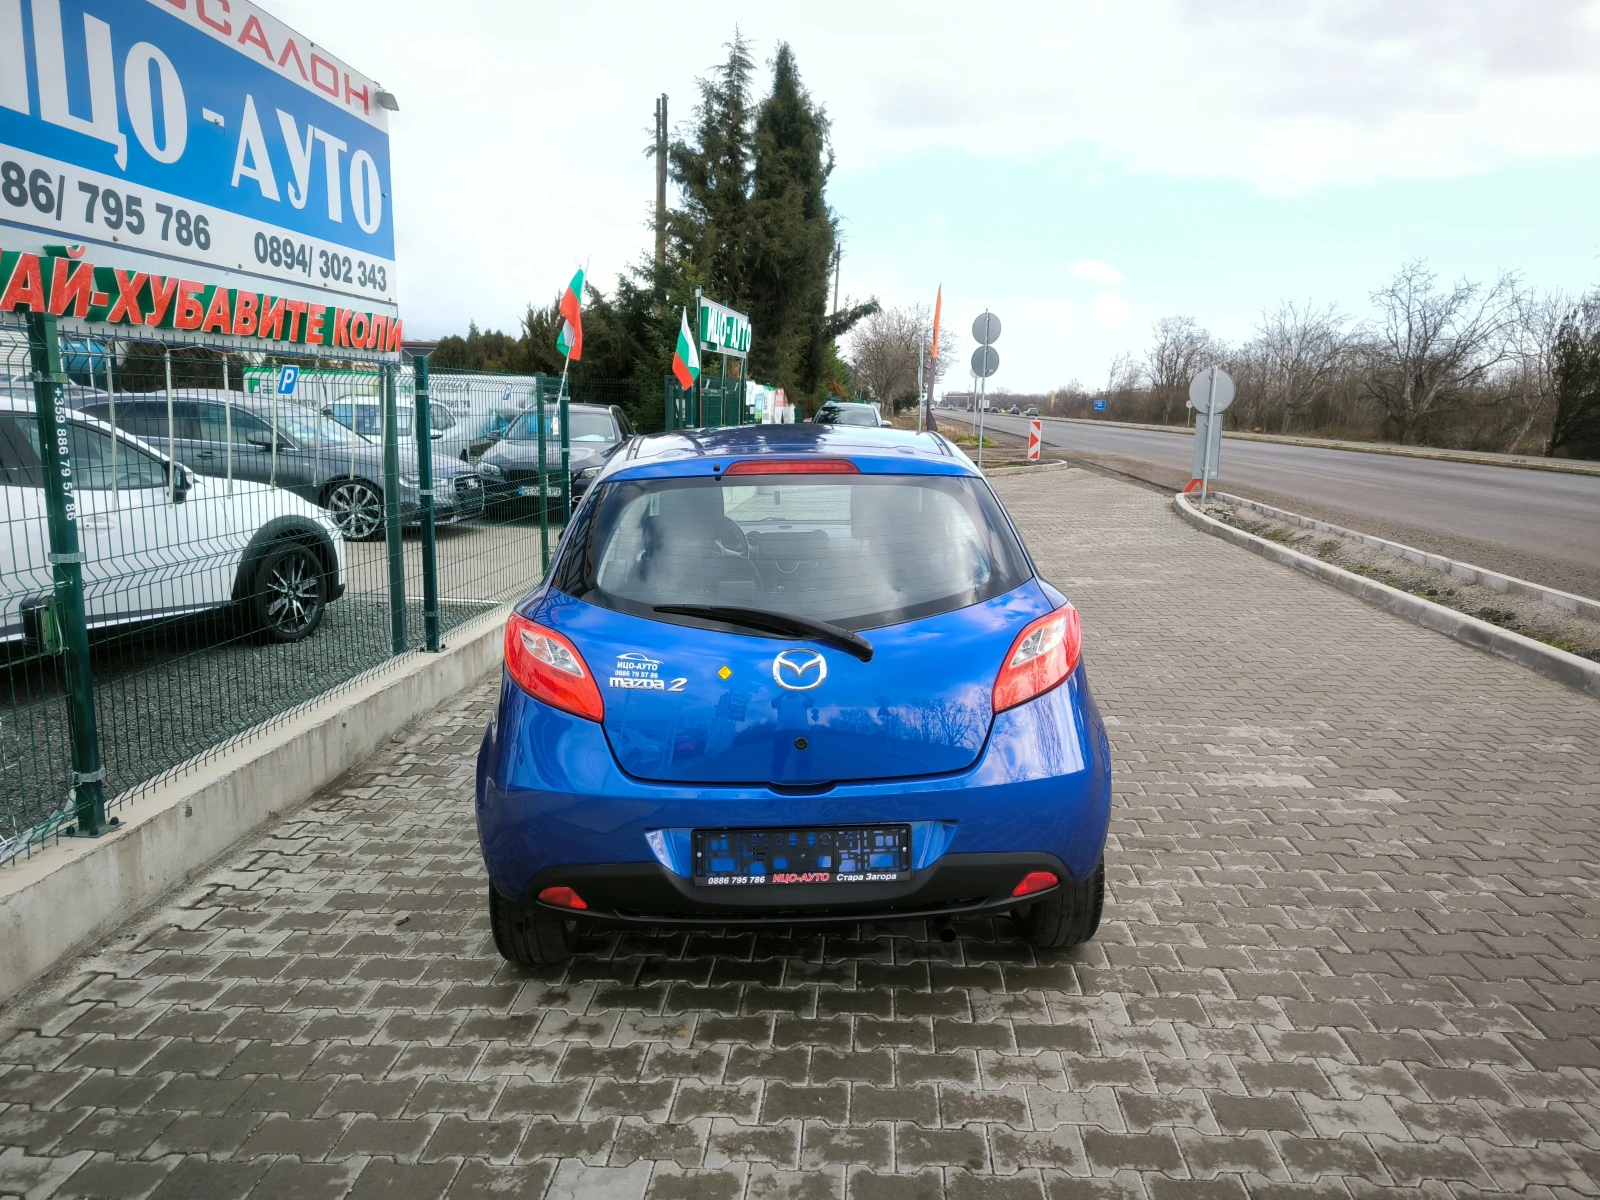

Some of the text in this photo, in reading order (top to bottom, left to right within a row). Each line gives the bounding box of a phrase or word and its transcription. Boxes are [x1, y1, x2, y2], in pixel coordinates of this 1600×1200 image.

[164, 0, 370, 116] САЛОН
[1, 161, 387, 292] 86/ 795 786 0894/ 302 343
[0, 245, 403, 353] АЙ-ХУБАВИТЕ КОЛИ
[707, 305, 752, 352] ИЦО-АУТО
[54, 387, 76, 521] +359 886 79 57 86
[617, 662, 658, 670] ИЦО-АУТО
[667, 678, 688, 692] 2
[708, 873, 897, 885] 0886 795 786 ИЦО-АУТО Стара Загора
